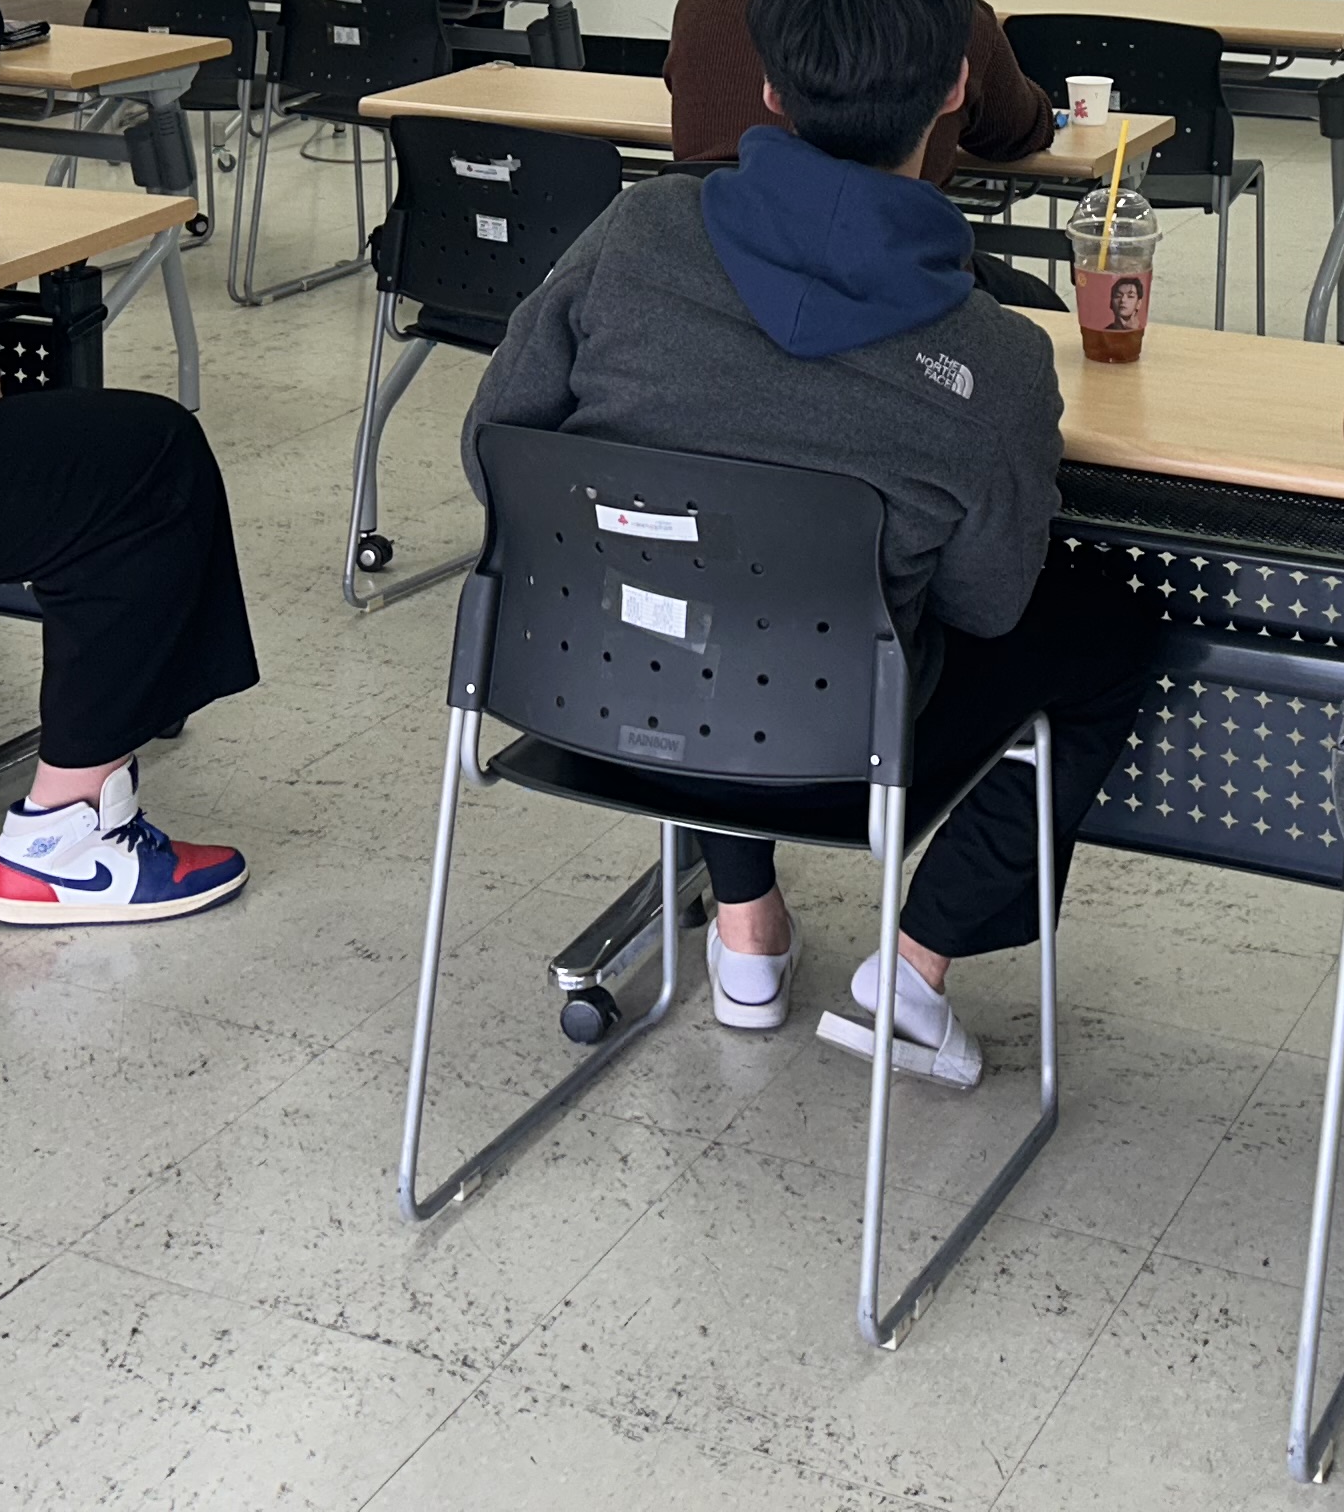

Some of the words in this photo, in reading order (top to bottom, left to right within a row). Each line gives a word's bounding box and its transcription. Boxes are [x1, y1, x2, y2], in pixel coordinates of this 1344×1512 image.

[915, 352, 957, 381] NORTH
[938, 352, 962, 372] THE
[923, 367, 953, 390] FACE
[627, 731, 680, 753] RAINBOW
